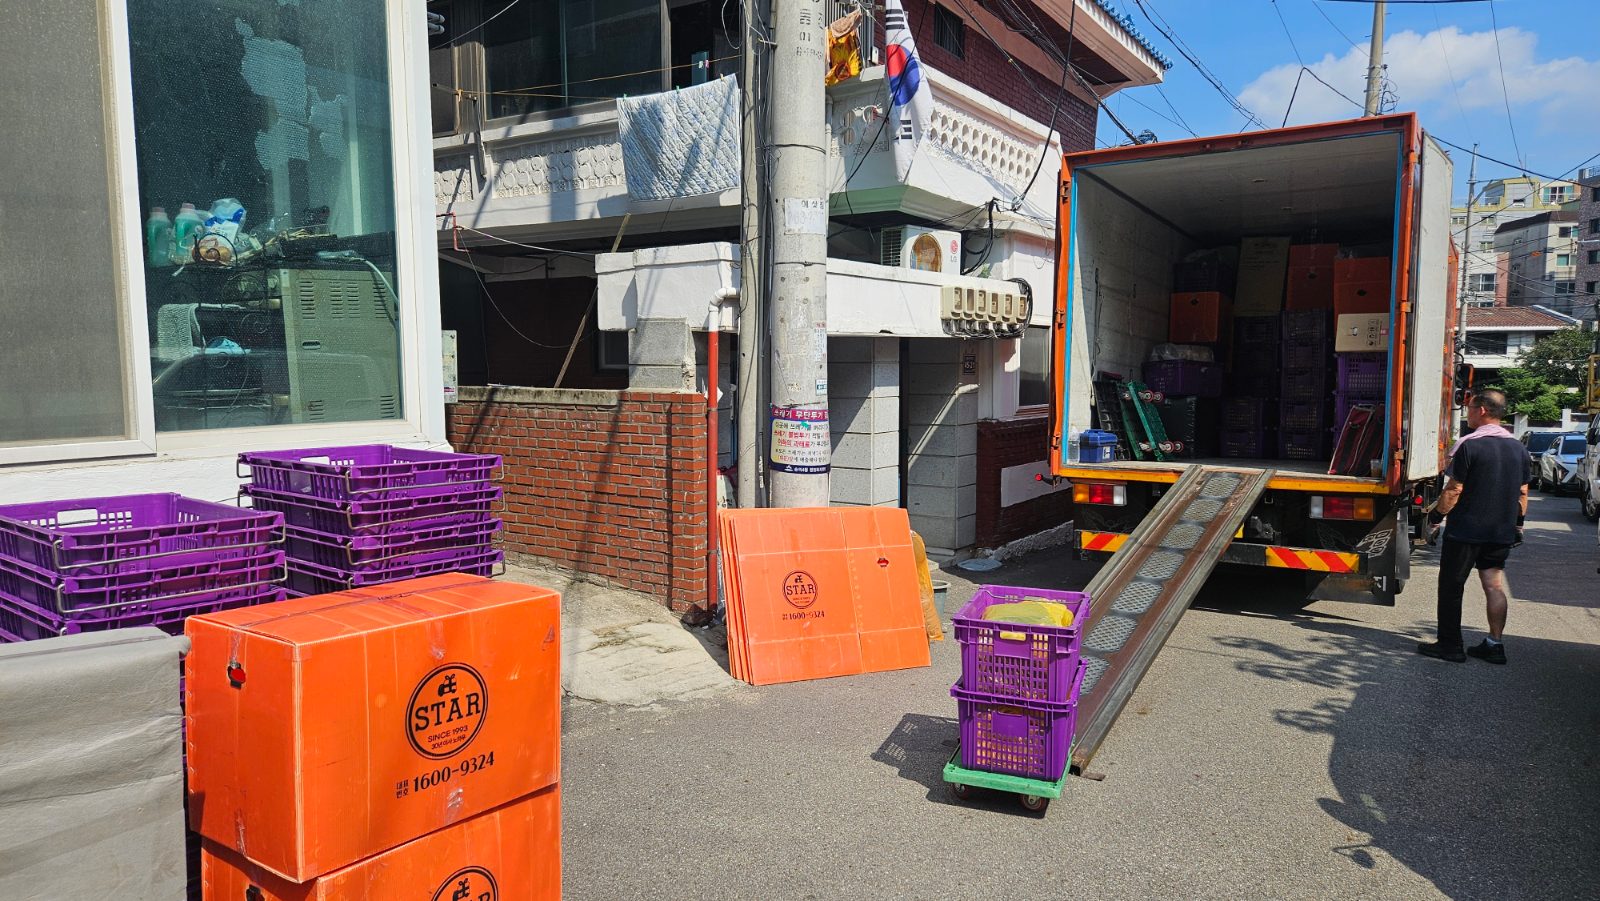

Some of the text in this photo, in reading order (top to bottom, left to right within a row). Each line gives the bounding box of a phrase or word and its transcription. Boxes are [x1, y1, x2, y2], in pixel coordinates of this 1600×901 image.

[773, 410, 792, 418] 쓰레기
[795, 410, 824, 420] 무단투기
[785, 583, 815, 596] STAR
[415, 692, 480, 732] STAR
[427, 725, 469, 743] SINCE 1993
[413, 751, 495, 793] 1600-9324
[396, 779, 409, 790] 대표
[396, 788, 409, 799] 번호
